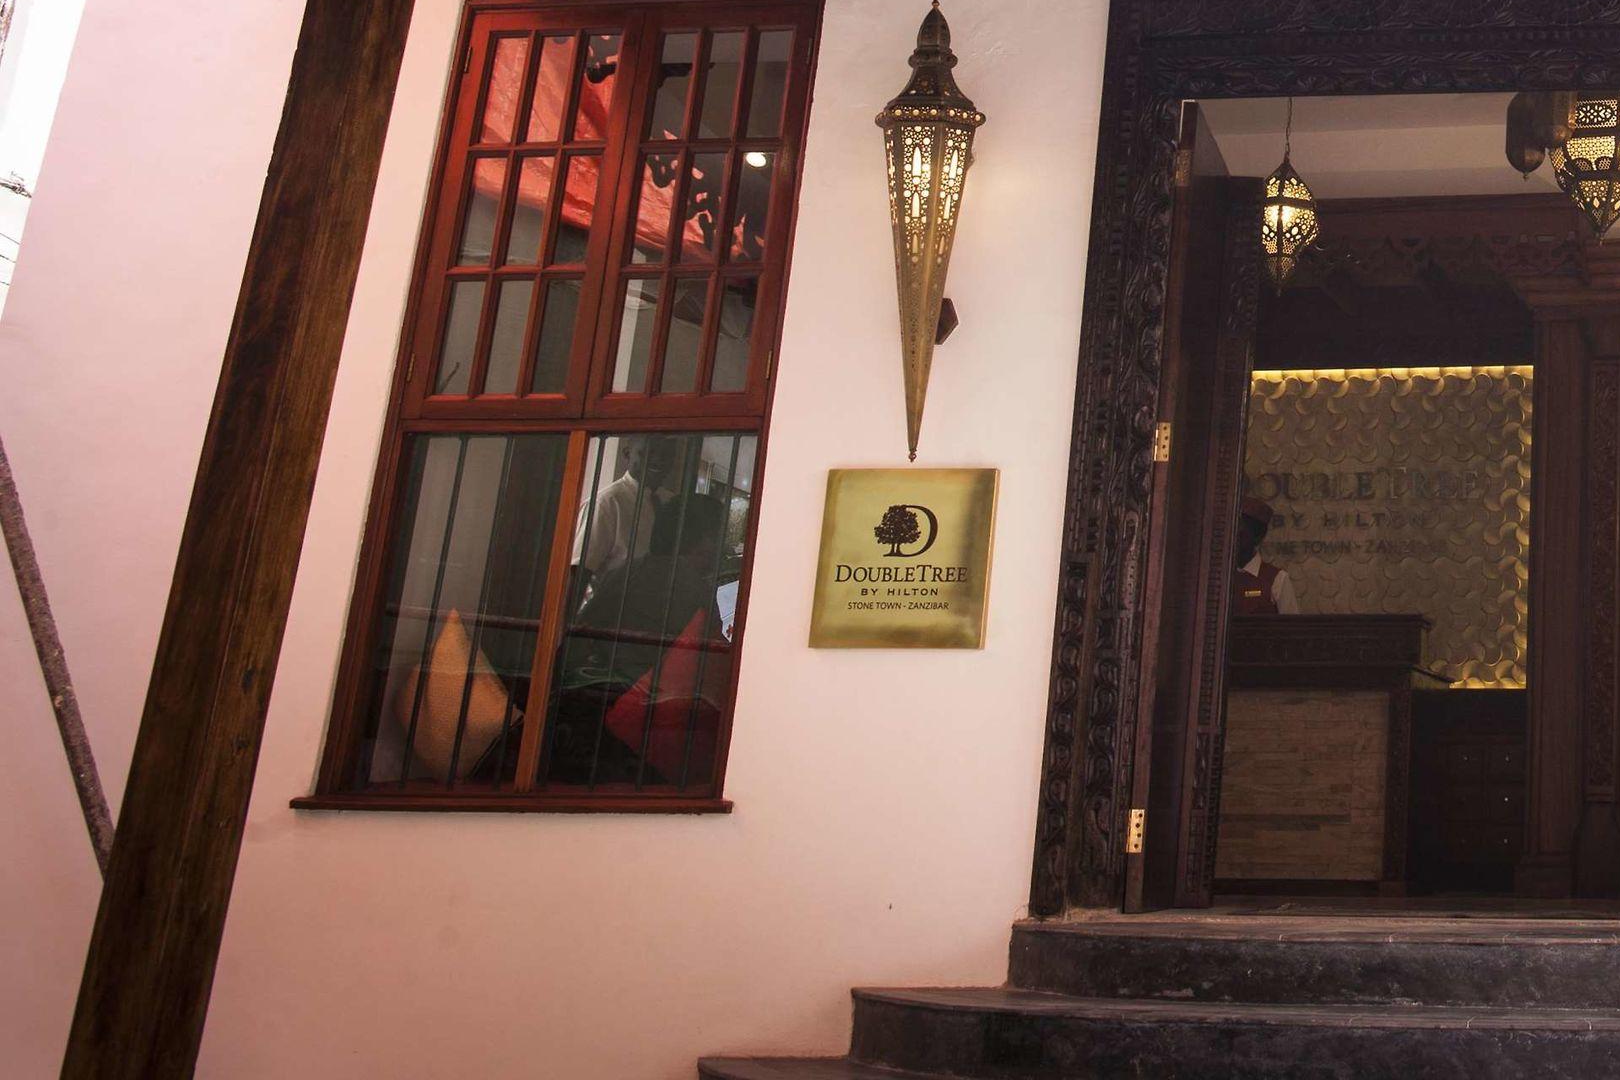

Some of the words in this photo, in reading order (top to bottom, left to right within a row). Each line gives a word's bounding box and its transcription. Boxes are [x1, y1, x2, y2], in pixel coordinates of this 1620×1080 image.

[1243, 467, 1481, 500] OUBLETREE
[1271, 513, 1304, 529] BY
[1324, 512, 1426, 529] HILTON
[860, 588, 878, 596] BY
[887, 587, 939, 596] HILTON
[847, 601, 875, 610] STONE
[875, 601, 902, 610] TOWN
[908, 601, 950, 610] ZANZIBAR
